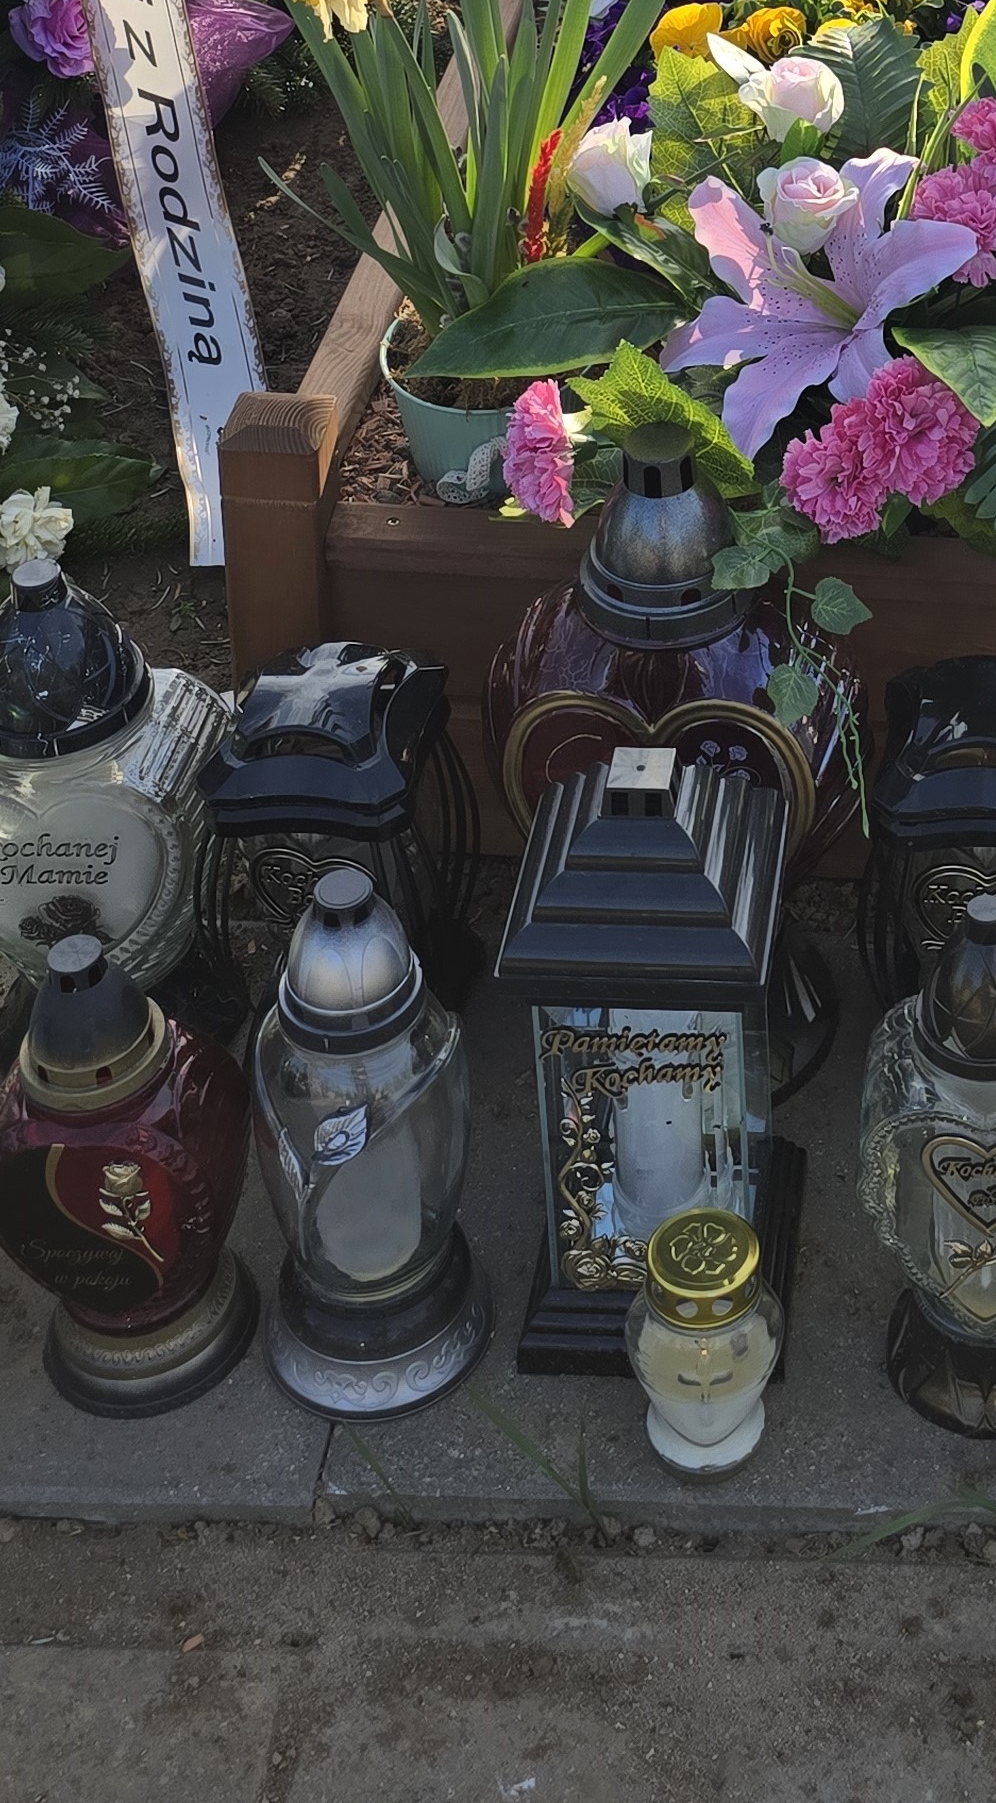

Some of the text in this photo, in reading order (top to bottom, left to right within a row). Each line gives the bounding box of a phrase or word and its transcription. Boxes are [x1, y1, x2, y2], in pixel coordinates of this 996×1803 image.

[124, 23, 158, 67] z
[137, 87, 222, 366] Rodziną
[0, 833, 119, 866] ochanej
[0, 864, 109, 885] Mamie
[539, 1024, 728, 1063] Pamiętamy
[572, 1057, 724, 1098] Kochamy
[21, 1238, 125, 1266] Spoczywaj
[72, 1270, 131, 1292] pokoju
